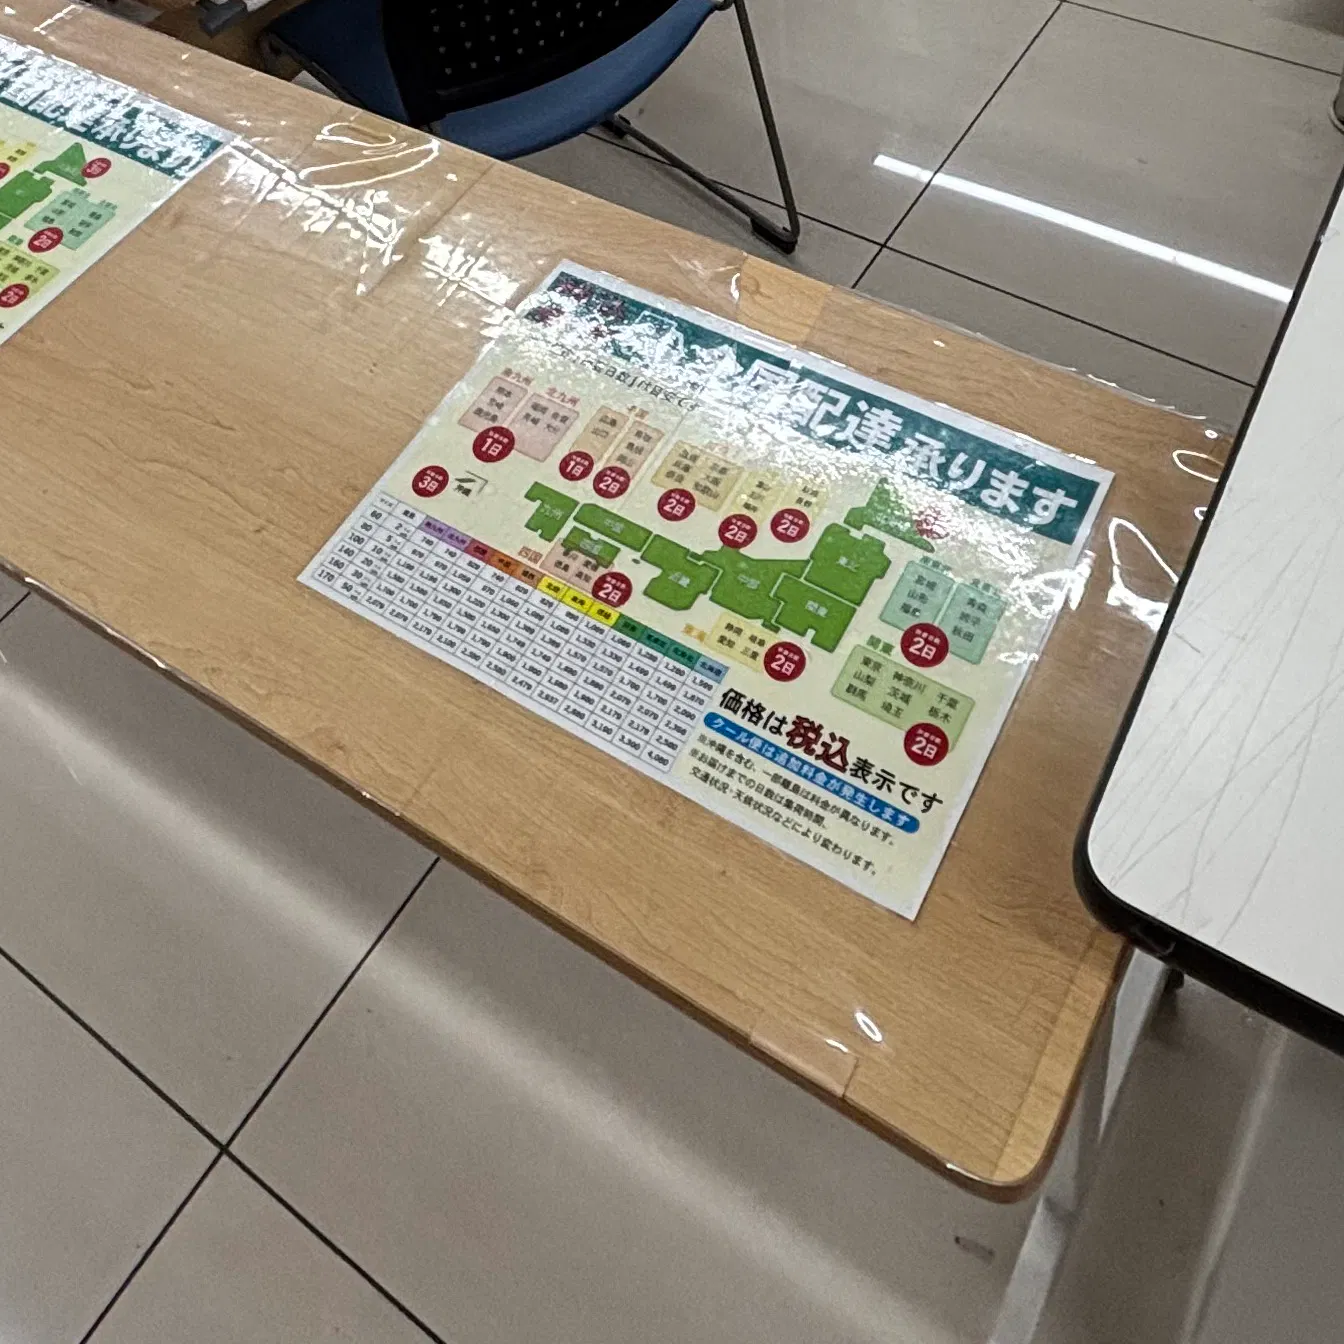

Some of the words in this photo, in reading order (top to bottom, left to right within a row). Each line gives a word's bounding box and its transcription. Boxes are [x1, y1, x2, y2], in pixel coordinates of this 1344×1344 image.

[478, 437, 505, 456] 1日
[563, 460, 585, 477] 1日
[417, 475, 440, 493] 3日
[597, 476, 621, 494] 2日
[663, 498, 686, 516] 2日
[724, 524, 748, 544] 2日
[775, 518, 800, 537] 2日
[337, 544, 355, 557] 140
[347, 532, 365, 545] 100
[370, 544, 383, 555] 10
[317, 569, 335, 582] 170
[597, 583, 623, 603] 2日
[908, 637, 937, 661] 2日
[769, 654, 795, 675] 2日
[860, 656, 883, 673] 東京
[852, 669, 876, 687] 山梨
[891, 671, 926, 695] 神奈川
[887, 685, 912, 705] 茨城
[926, 705, 952, 725] 栃木
[715, 679, 949, 821] 価格は税込表示です
[911, 736, 937, 759] 2日
[709, 715, 912, 830] クール便は追加料金が発生します
